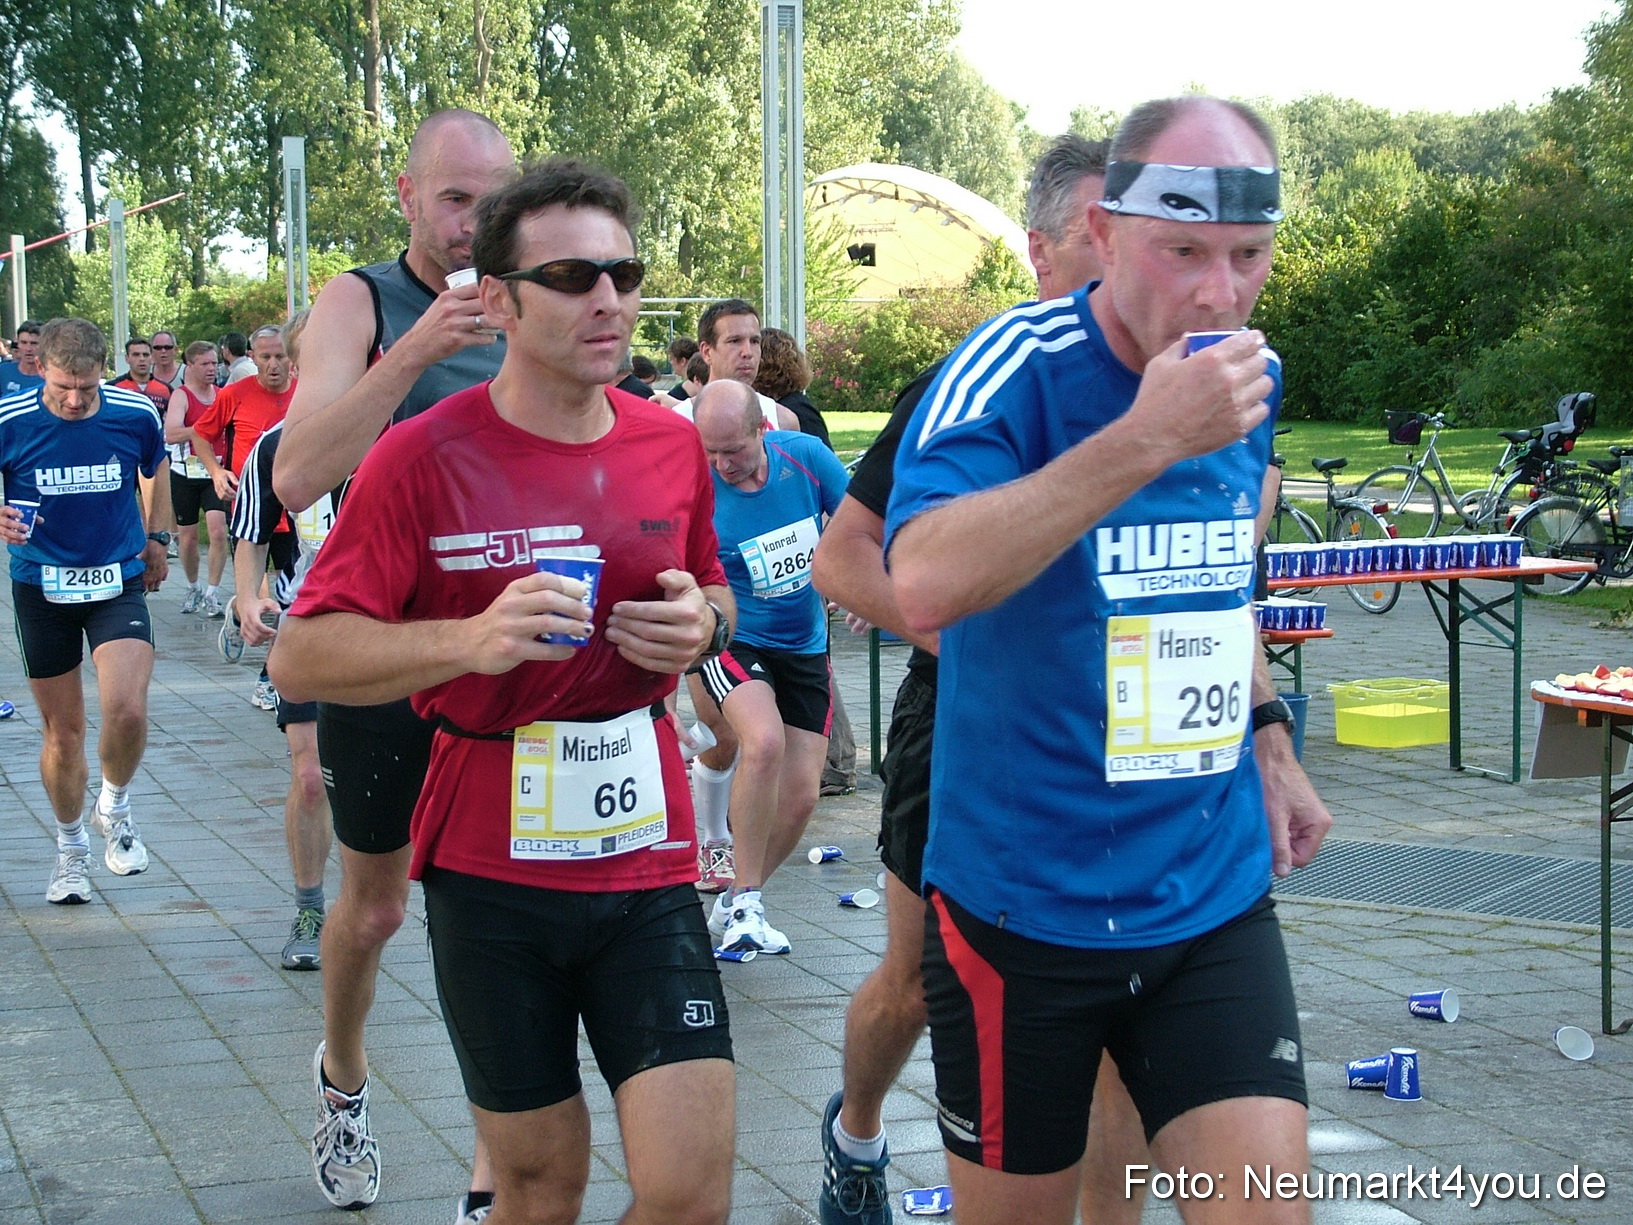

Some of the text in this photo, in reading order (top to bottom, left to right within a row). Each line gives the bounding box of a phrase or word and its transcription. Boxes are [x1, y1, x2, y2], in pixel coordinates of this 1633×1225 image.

[35, 463, 122, 486] HUBER
[56, 482, 120, 493] TECHNOLOGY
[762, 531, 798, 553] konrad
[1096, 519, 1255, 573] HUBER
[752, 565, 758, 575] B
[772, 547, 815, 579] 2864
[65, 568, 115, 586] 2480
[1158, 629, 1221, 659] Hans-
[1117, 681, 1128, 703] B
[1178, 681, 1240, 730] 296
[563, 727, 632, 762] Michael
[1110, 754, 1178, 772] BOCK
[521, 776, 531, 794] C
[594, 776, 637, 819] 66
[618, 820, 665, 845] PFLEIDERER
[514, 839, 579, 853] BOCK
